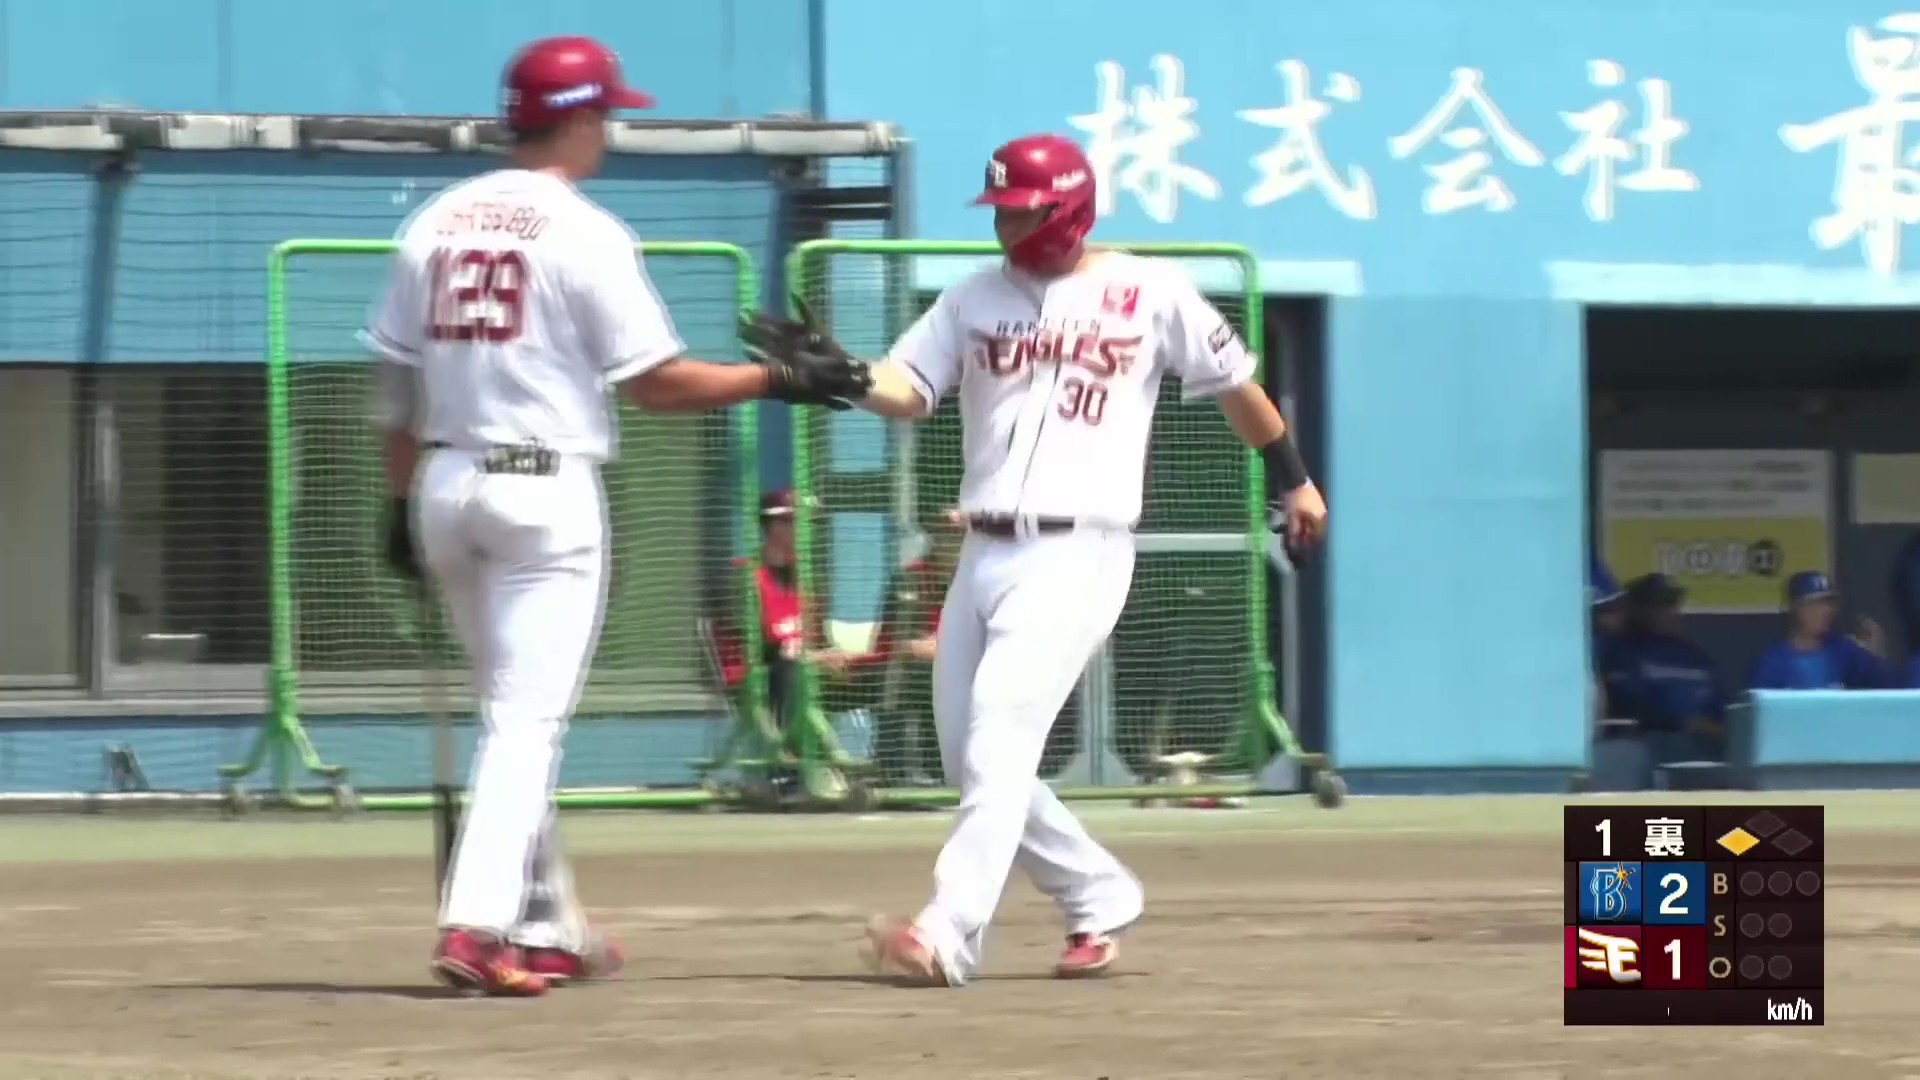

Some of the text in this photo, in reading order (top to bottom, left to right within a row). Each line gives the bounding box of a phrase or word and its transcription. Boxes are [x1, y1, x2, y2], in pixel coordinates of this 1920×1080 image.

[1066, 53, 1702, 223] 株式会社
[1057, 376, 1109, 427] 30
